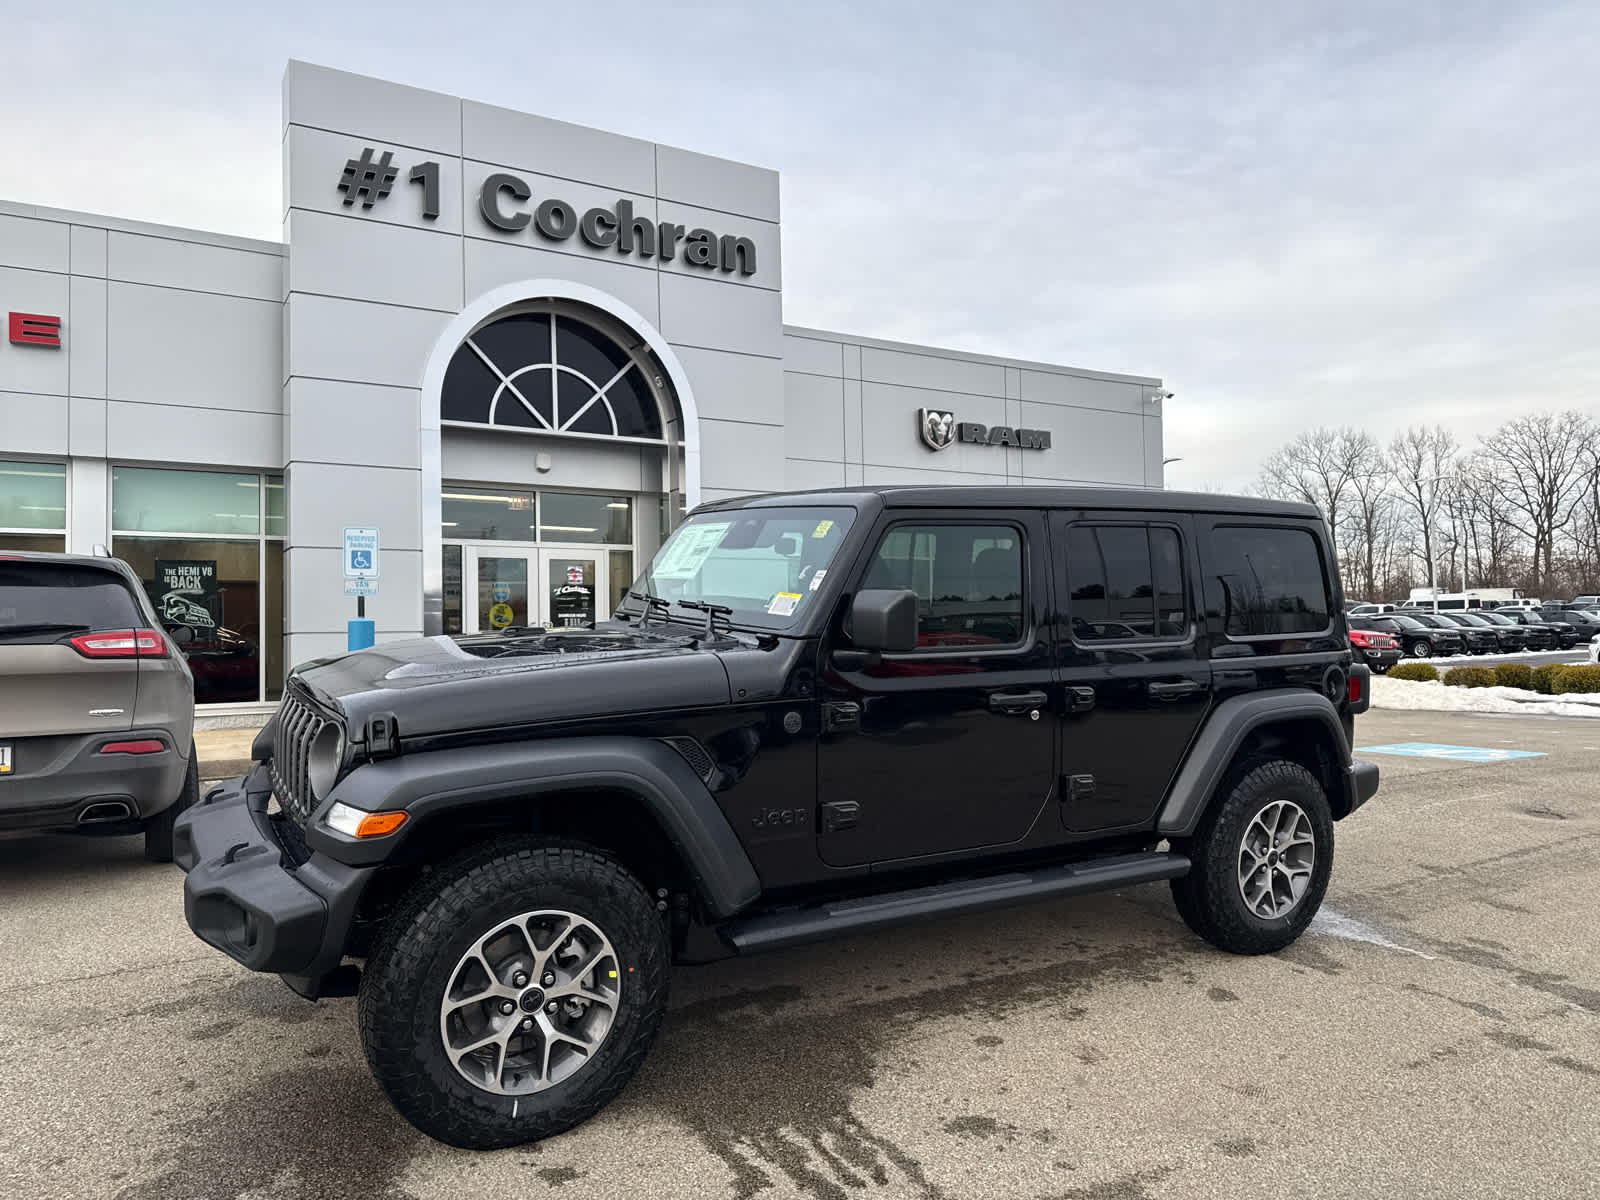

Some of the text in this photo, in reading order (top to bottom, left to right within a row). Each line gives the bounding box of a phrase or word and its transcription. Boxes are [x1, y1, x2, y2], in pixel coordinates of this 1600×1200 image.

[337, 147, 757, 276] #1 Cochran
[9, 311, 61, 350] E
[957, 422, 1051, 450] RAM
[165, 566, 213, 577] THE HEMI V8
[170, 575, 202, 589] BACK
[752, 807, 808, 826] Jeep
